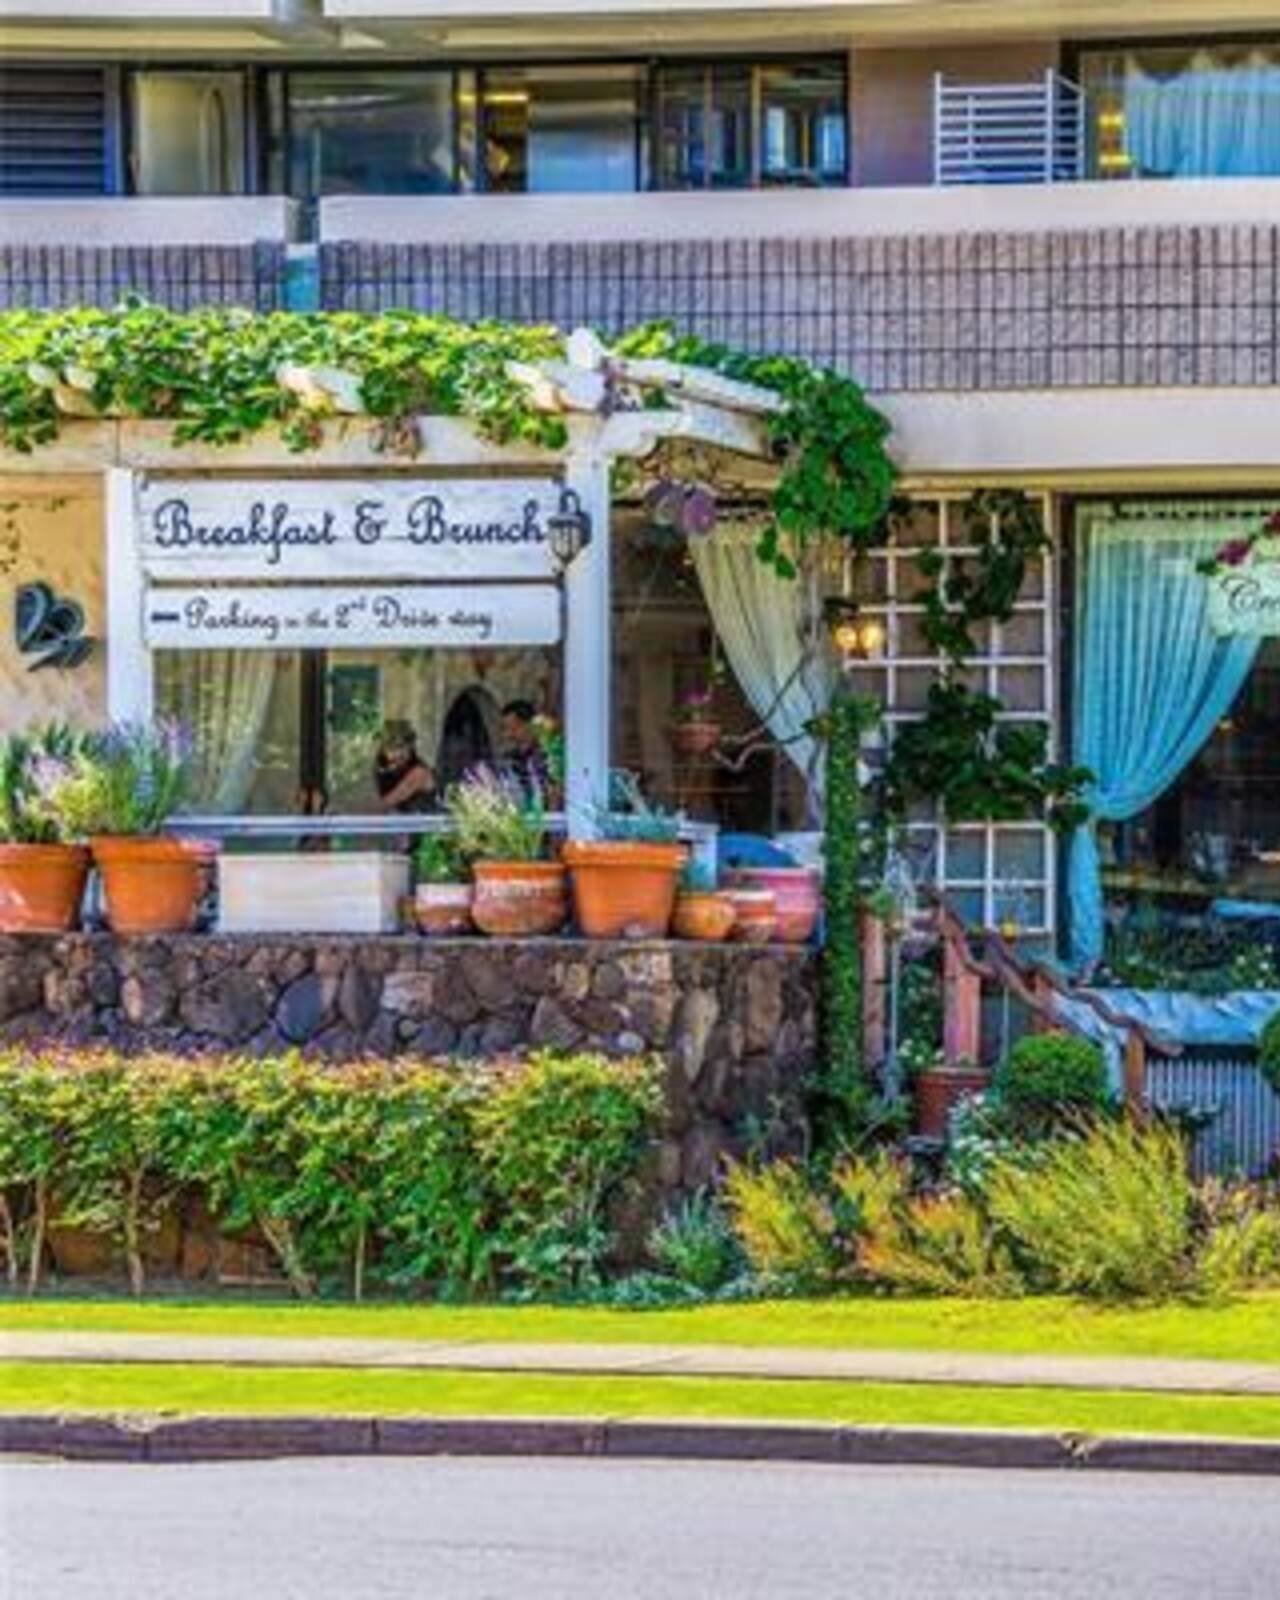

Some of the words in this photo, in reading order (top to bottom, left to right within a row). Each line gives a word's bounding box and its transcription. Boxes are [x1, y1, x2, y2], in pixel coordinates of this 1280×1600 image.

[153, 498, 336, 564] Breakfast
[354, 502, 388, 546] &
[406, 495, 548, 545] Brunch
[184, 595, 280, 640] Parking
[371, 595, 440, 629] Drive
